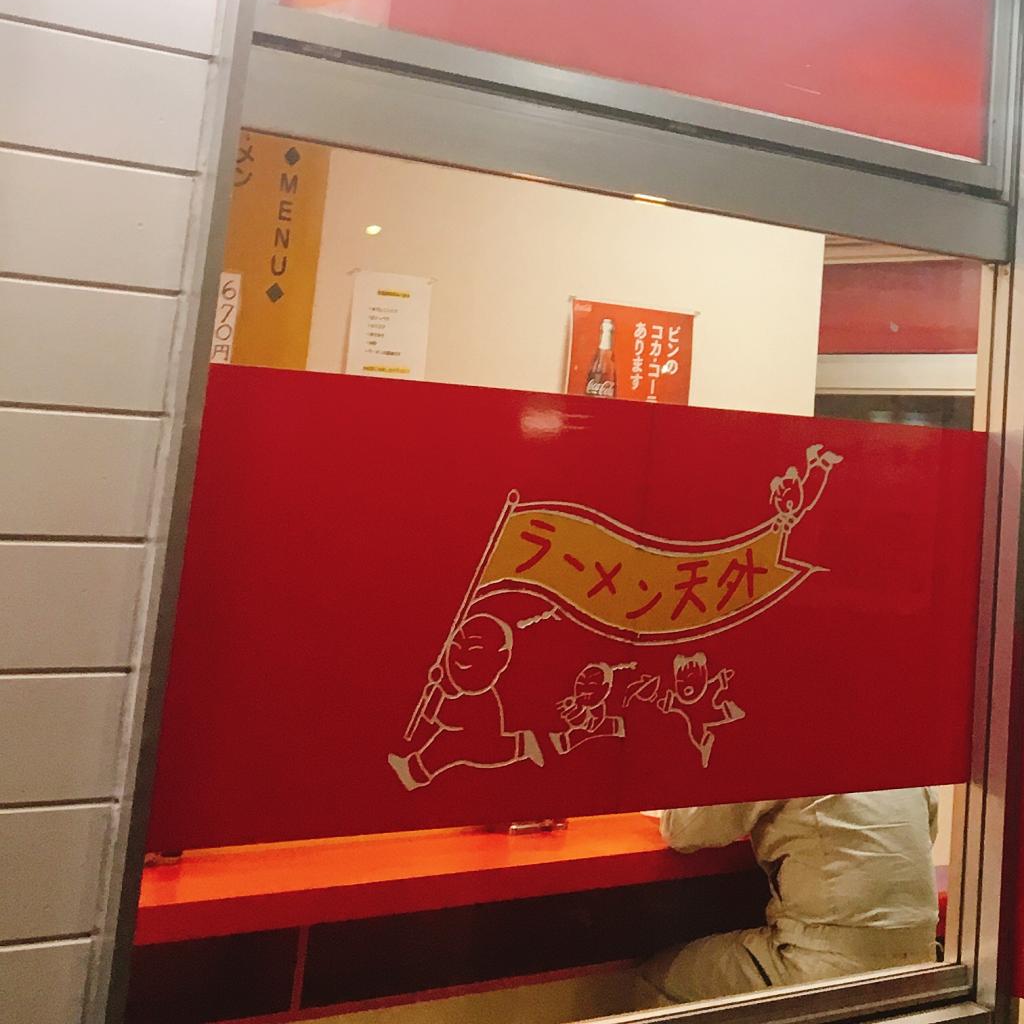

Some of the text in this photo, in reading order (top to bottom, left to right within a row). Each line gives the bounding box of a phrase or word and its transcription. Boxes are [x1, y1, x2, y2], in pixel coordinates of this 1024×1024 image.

[270, 173, 298, 277] MENU
[211, 279, 237, 362] 670円
[630, 322, 647, 390] あります
[667, 326, 681, 375] ビンの
[516, 519, 768, 620] ラーメン天外
